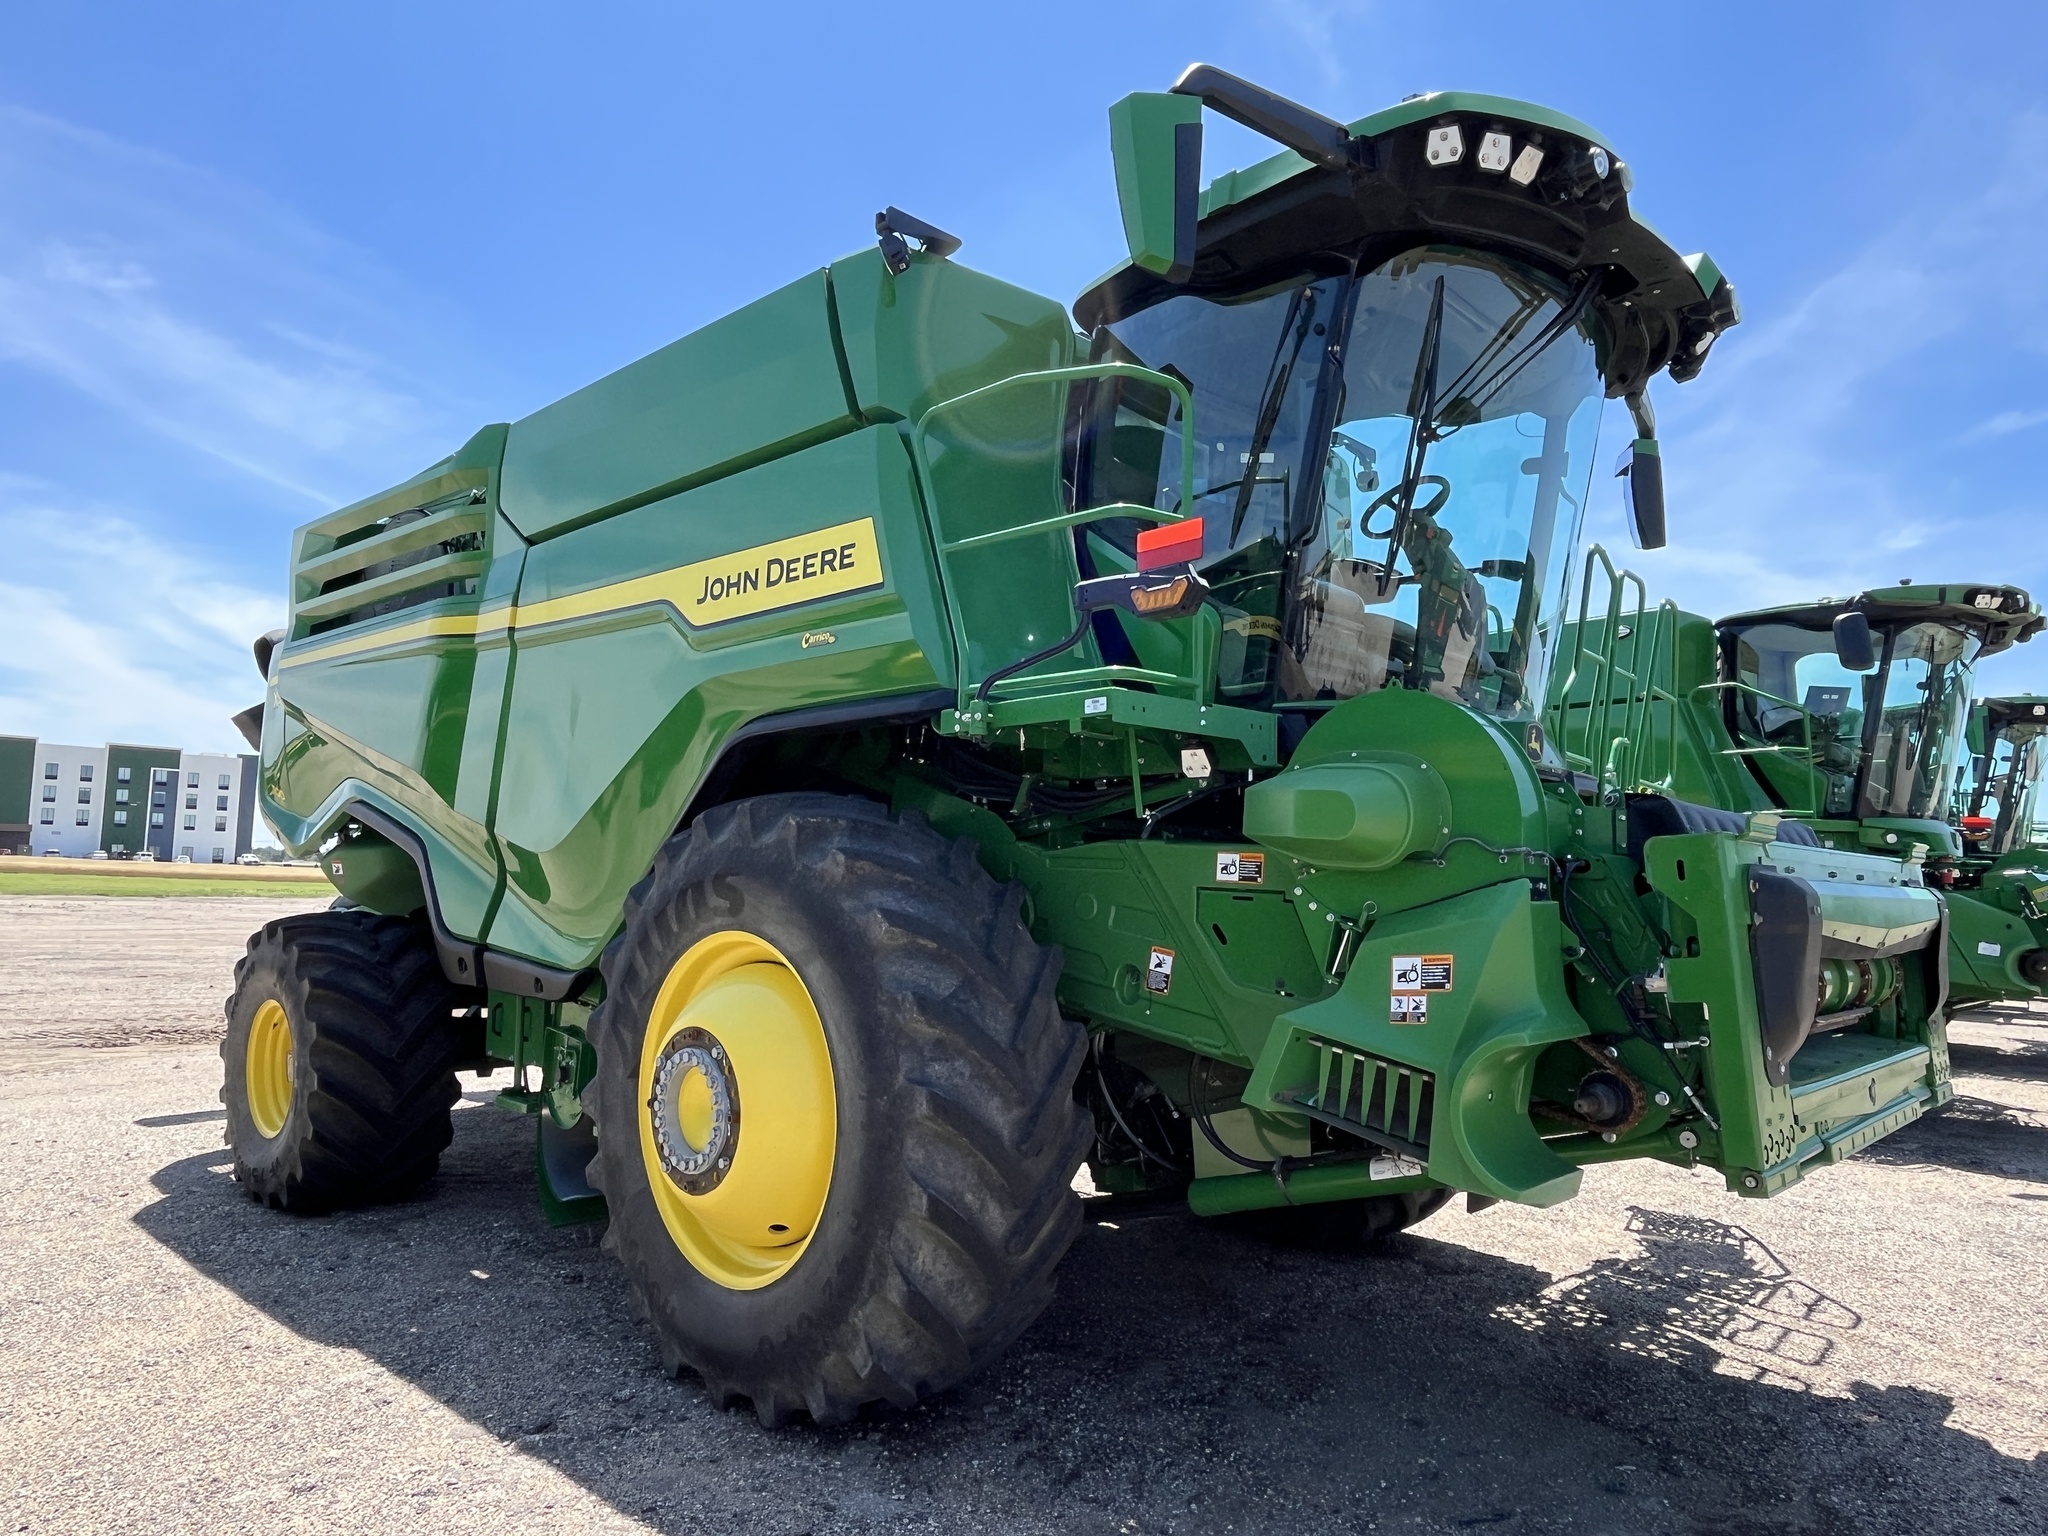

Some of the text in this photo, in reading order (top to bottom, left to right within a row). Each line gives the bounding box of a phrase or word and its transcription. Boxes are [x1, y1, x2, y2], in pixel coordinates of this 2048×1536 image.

[696, 542, 856, 605] JOHN DEERE
[801, 632, 831, 649] Carrico
